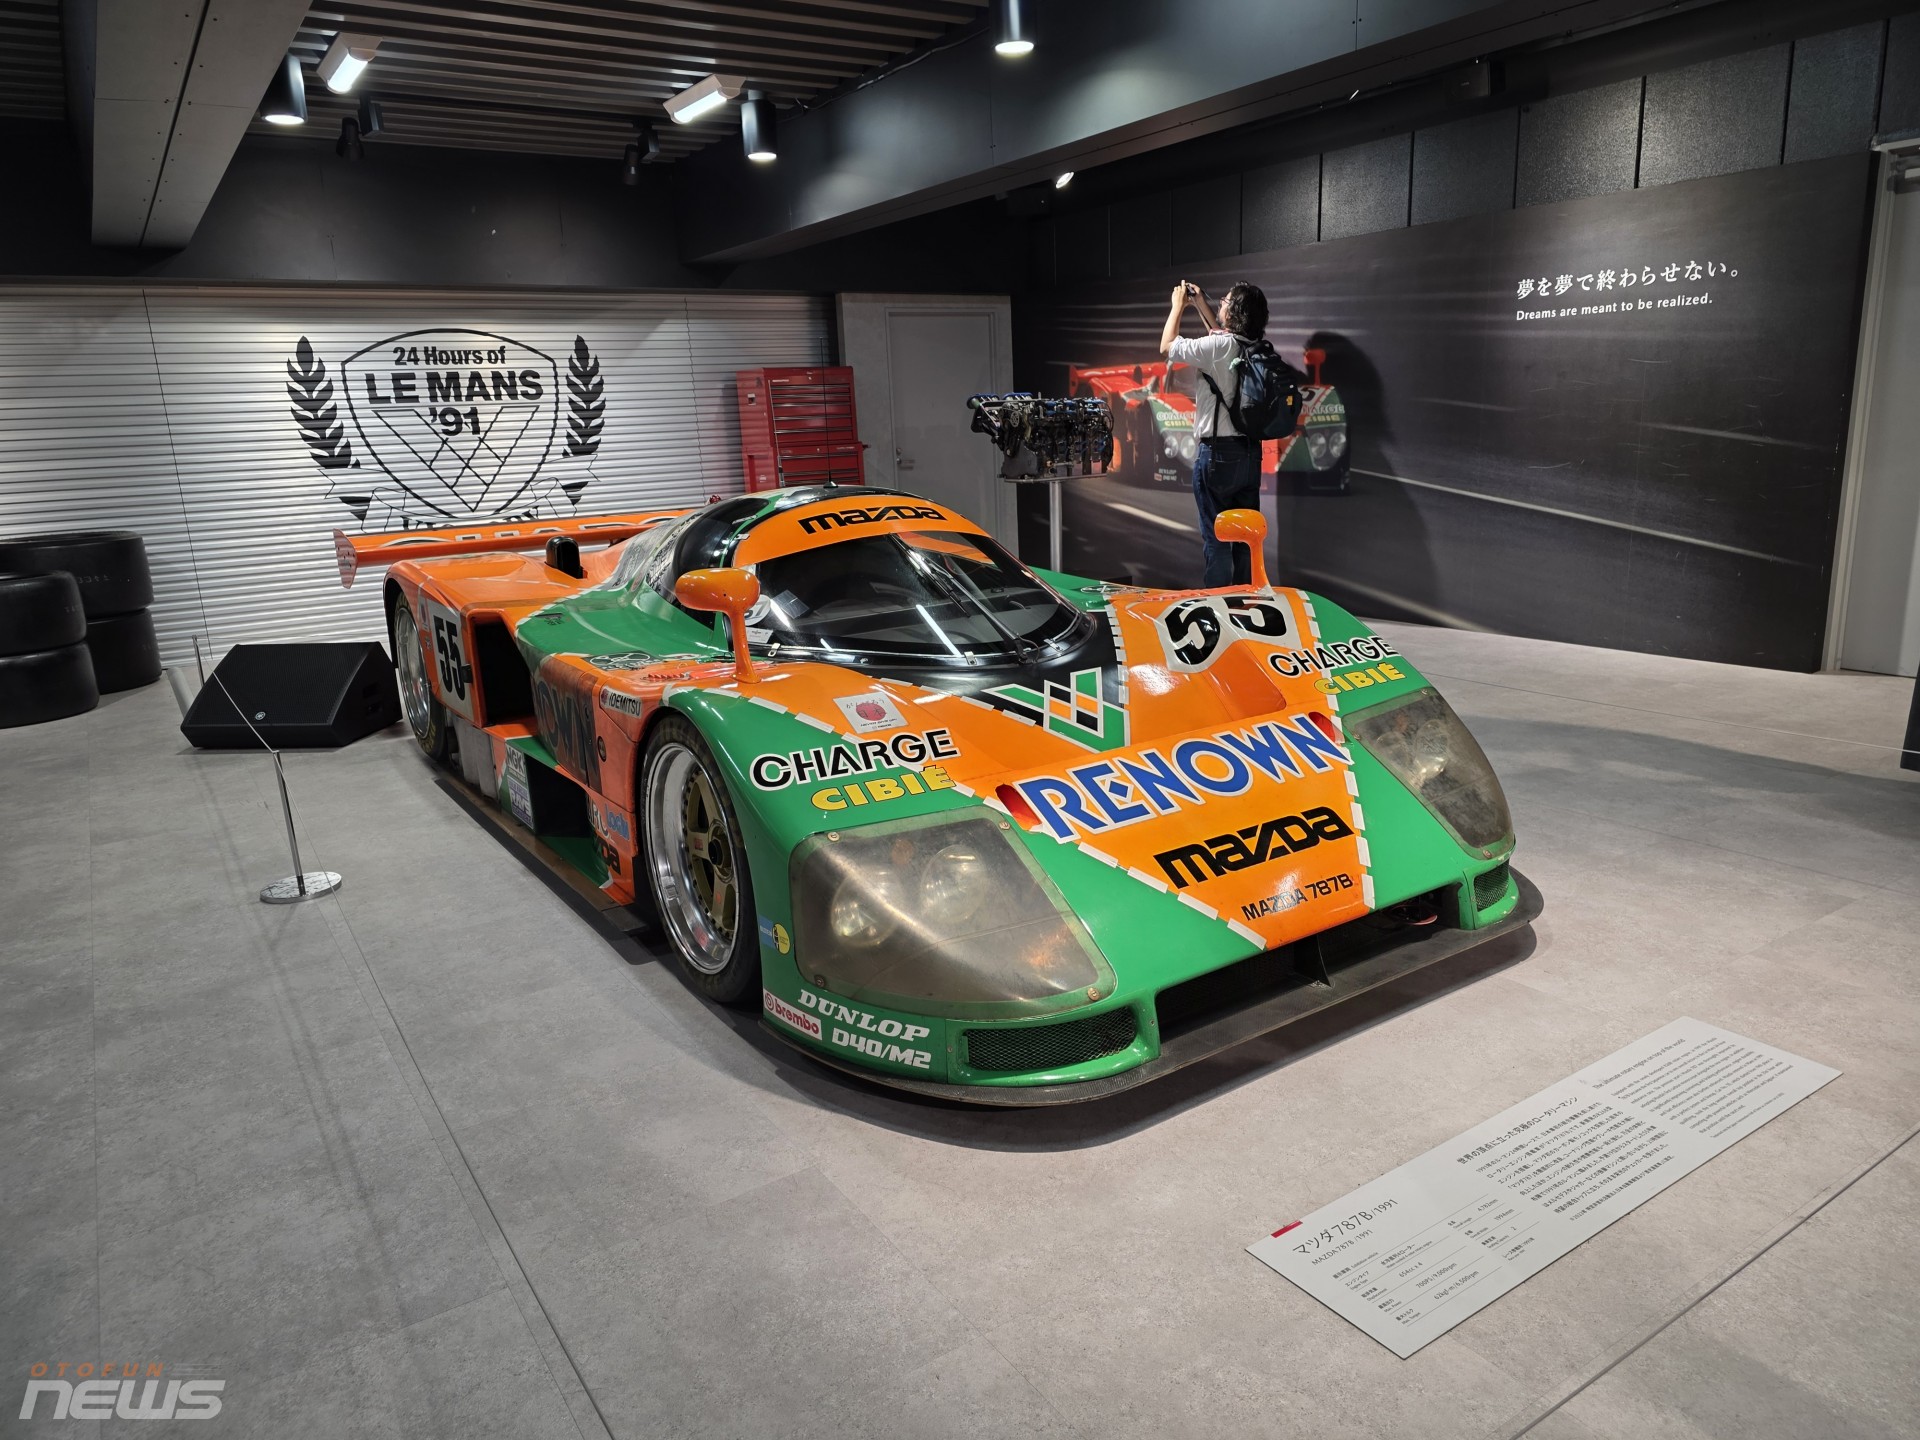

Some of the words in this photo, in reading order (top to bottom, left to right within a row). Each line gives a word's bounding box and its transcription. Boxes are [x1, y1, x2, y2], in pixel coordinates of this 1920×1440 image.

[1516, 260, 1738, 300] 夢を夢で終わらせない。
[1516, 309, 1556, 321] Dreams
[1560, 307, 1577, 317] are
[1581, 303, 1617, 315] meant
[1621, 301, 1634, 312] to
[1638, 299, 1653, 310] be
[1657, 292, 1713, 308] realized.
[393, 346, 419, 365] 24
[424, 345, 482, 366] Hours
[486, 345, 506, 365] of
[365, 373, 420, 404] LE
[426, 369, 543, 403] MANS
[1164, 596, 1287, 666] 55
[433, 615, 466, 701] 55
[1268, 635, 1398, 678] CHARGE
[750, 727, 961, 792] CHARGE
[1012, 714, 1353, 844] RENOWN
[1241, 887, 1308, 921] MAZDA
[1305, 873, 1354, 900] 787B
[774, 999, 820, 1035] brembo
[797, 989, 931, 1042] DUNLOP
[831, 1027, 933, 1070] D40/M2
